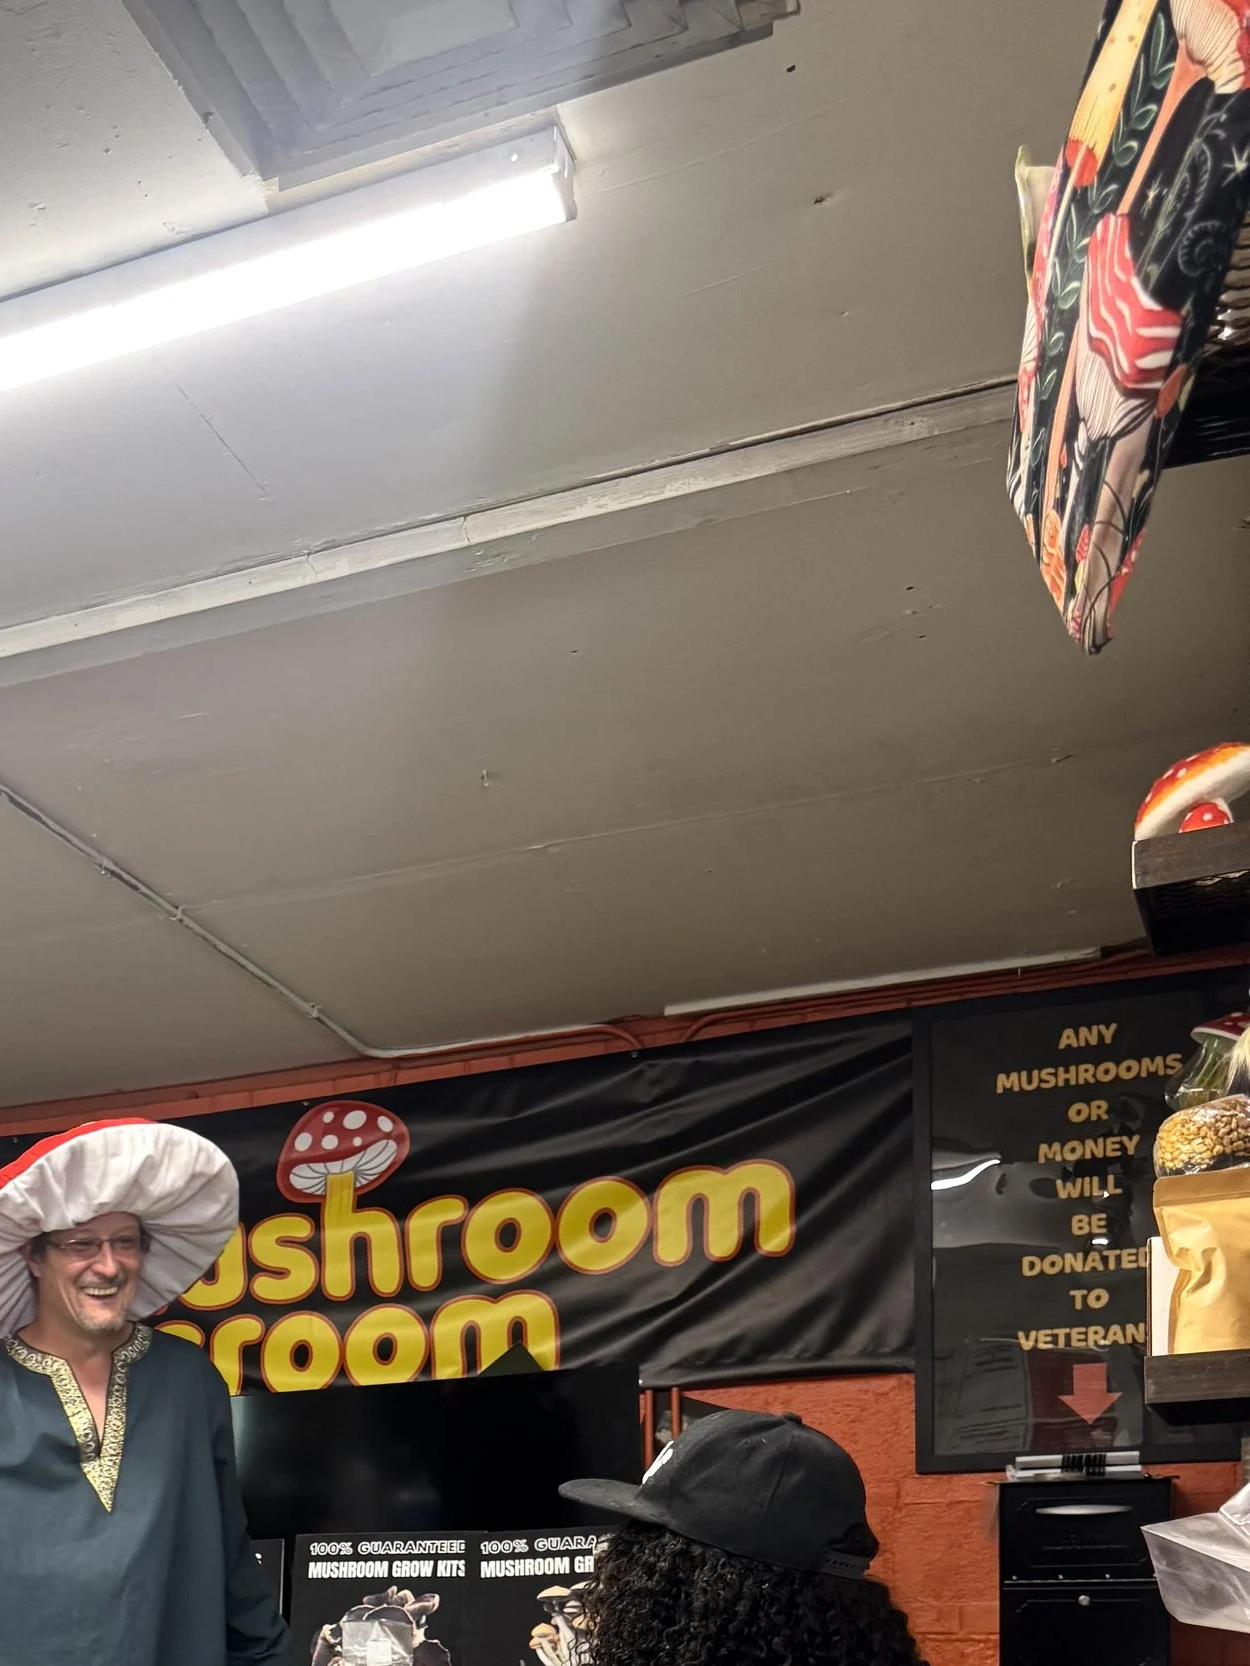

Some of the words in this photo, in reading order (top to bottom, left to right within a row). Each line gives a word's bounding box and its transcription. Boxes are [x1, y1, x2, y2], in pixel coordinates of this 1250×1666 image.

[1058, 1023, 1117, 1049] ANY
[996, 1053, 1182, 1094] MUSHROOMS
[1067, 1100, 1109, 1123] OR
[1038, 1134, 1140, 1163] MONEY
[1055, 1174, 1123, 1200] WILL
[1071, 1213, 1107, 1236] BE
[1069, 1288, 1110, 1310] TO
[1018, 1322, 1146, 1350] VETERAN
[310, 1542, 353, 1555] 100%
[480, 1540, 528, 1555] 100%
[534, 1535, 596, 1551] GUARA
[308, 1560, 388, 1579] MUSHROOM
[392, 1560, 434, 1577] GROW
[480, 1557, 570, 1578] MUSHROOM
[573, 1555, 594, 1573] GR
